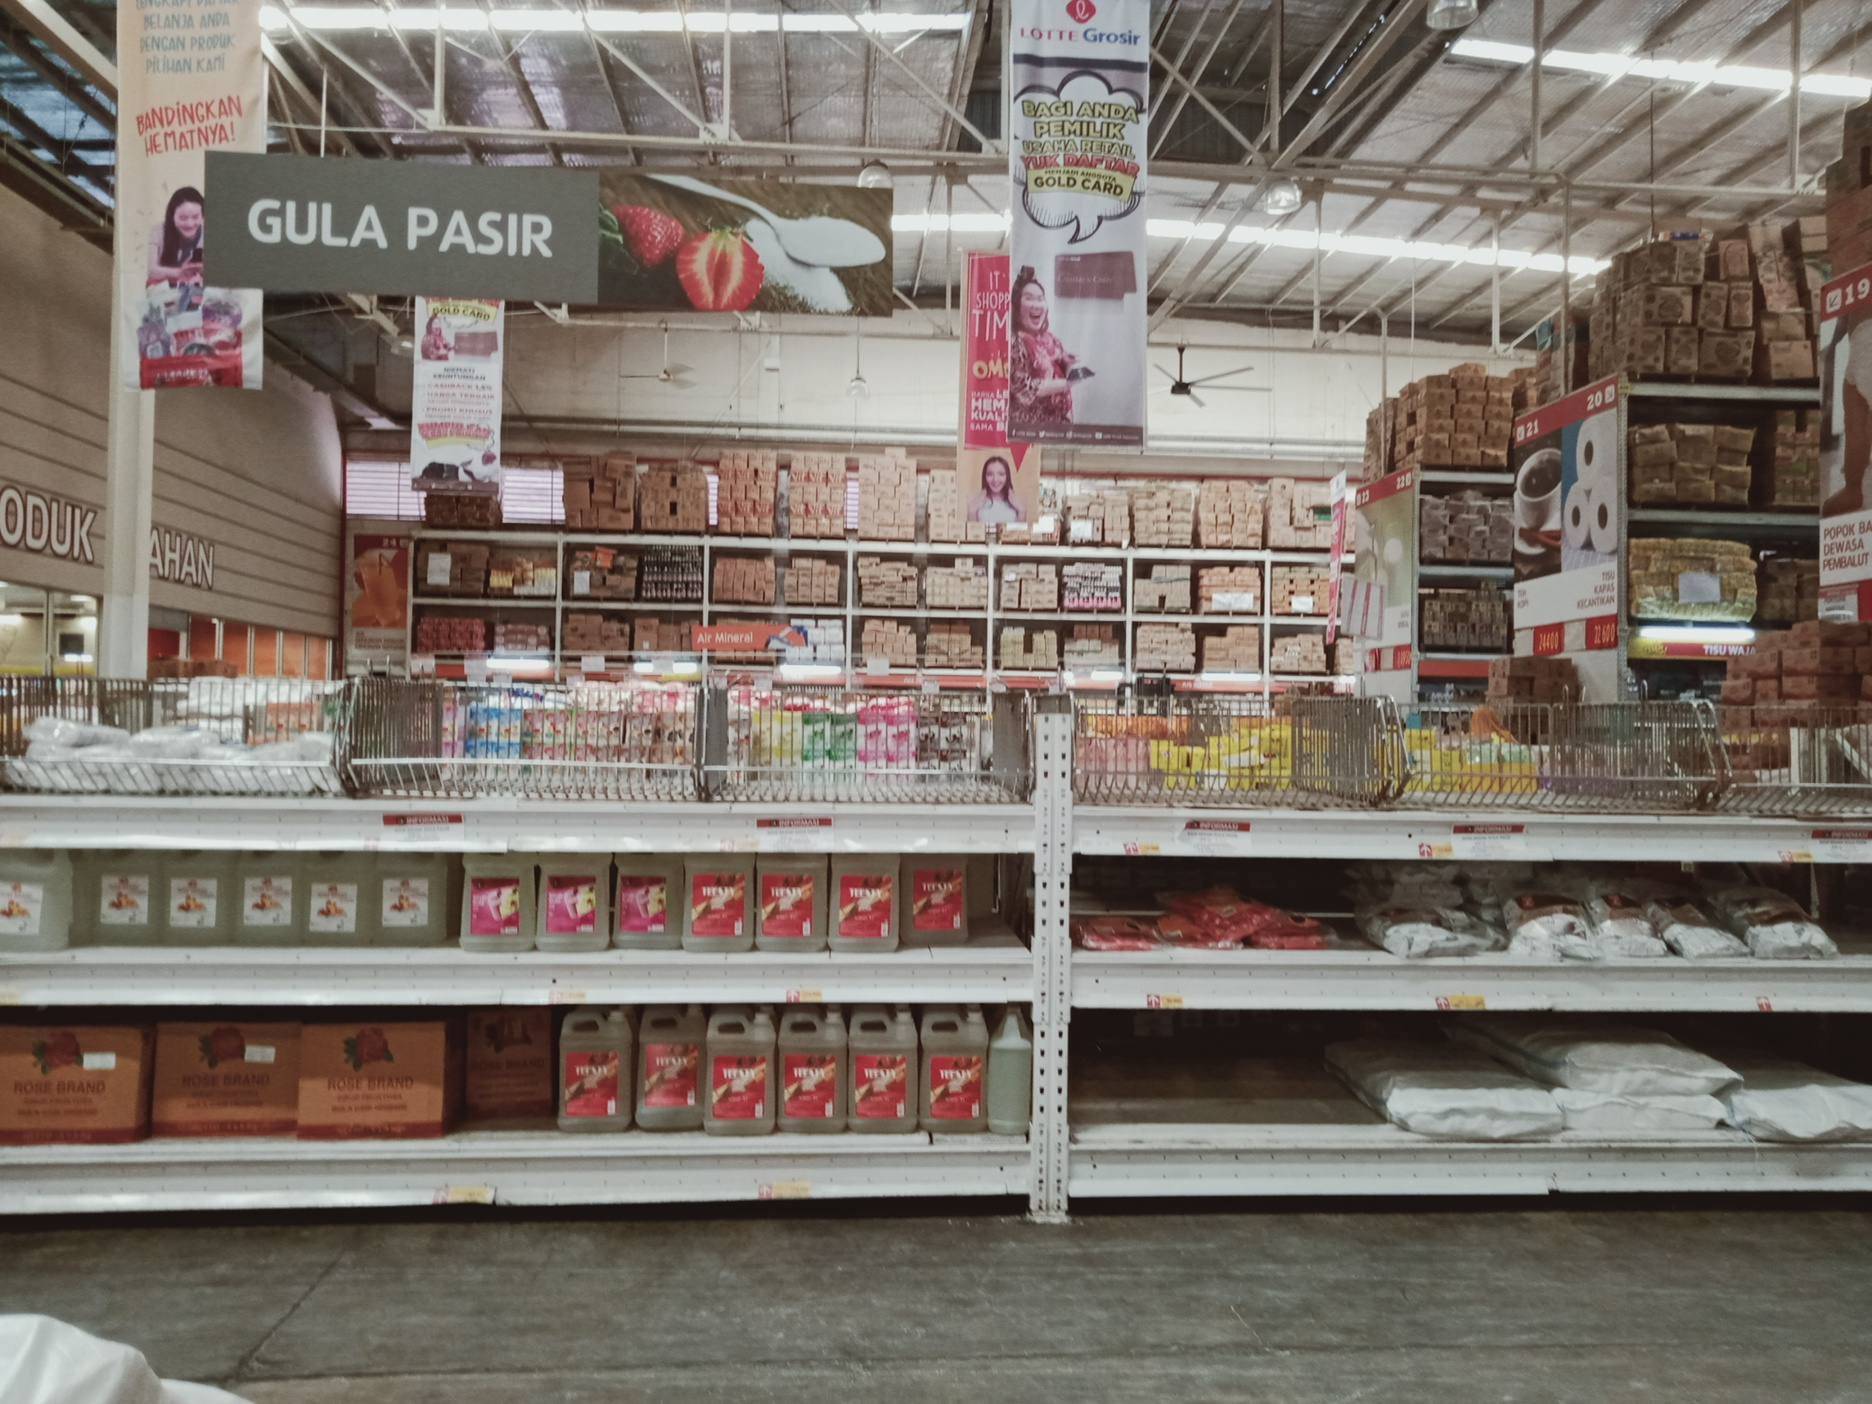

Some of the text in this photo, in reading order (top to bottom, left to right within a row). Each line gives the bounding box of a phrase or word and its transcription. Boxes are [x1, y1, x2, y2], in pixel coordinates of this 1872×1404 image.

[143, 12, 230, 31] BELANJA ANDA
[140, 34, 236, 54] DENGAN PRODUK
[1020, 27, 1141, 46] LOTTE Grosir
[146, 53, 225, 74] PILIHAN KAMI
[136, 95, 243, 136] BANDINGKAN
[1022, 100, 1139, 124] BAGI ANDA
[145, 121, 235, 157] HEMATNYA!
[1034, 120, 1125, 140] PEMILIK
[1022, 139, 1136, 160] USAHA RETAIL
[1021, 154, 1140, 177] YUK DAFTAR
[1034, 176, 1124, 197] GOLD CARD
[1080, 171, 1117, 183] ANGGOTA
[248, 198, 553, 258] GULA PASIR
[1845, 278, 1870, 306] 19
[433, 307, 460, 315] GOLD
[971, 398, 1009, 412] HEM
[1587, 391, 1603, 411] 20
[1525, 419, 1539, 439] 21
[1396, 474, 1405, 489] 22
[1361, 490, 1369, 505] 23
[0, 486, 97, 563] ODUK
[1824, 523, 1855, 540] POPOK
[1824, 538, 1864, 556] DEWASA
[150, 528, 214, 589] AHAN
[1823, 552, 1869, 571] PEMBALUT
[1601, 571, 1615, 581] TISU
[1593, 582, 1615, 594] KAPAS
[1577, 595, 1615, 610] KECANTIKAN
[697, 632, 753, 643] Air Mineral
[1703, 645, 1727, 655] TISU
[14, 1080, 106, 1094] ROSE BRAND
[327, 1076, 414, 1091] ROSE BRAND
